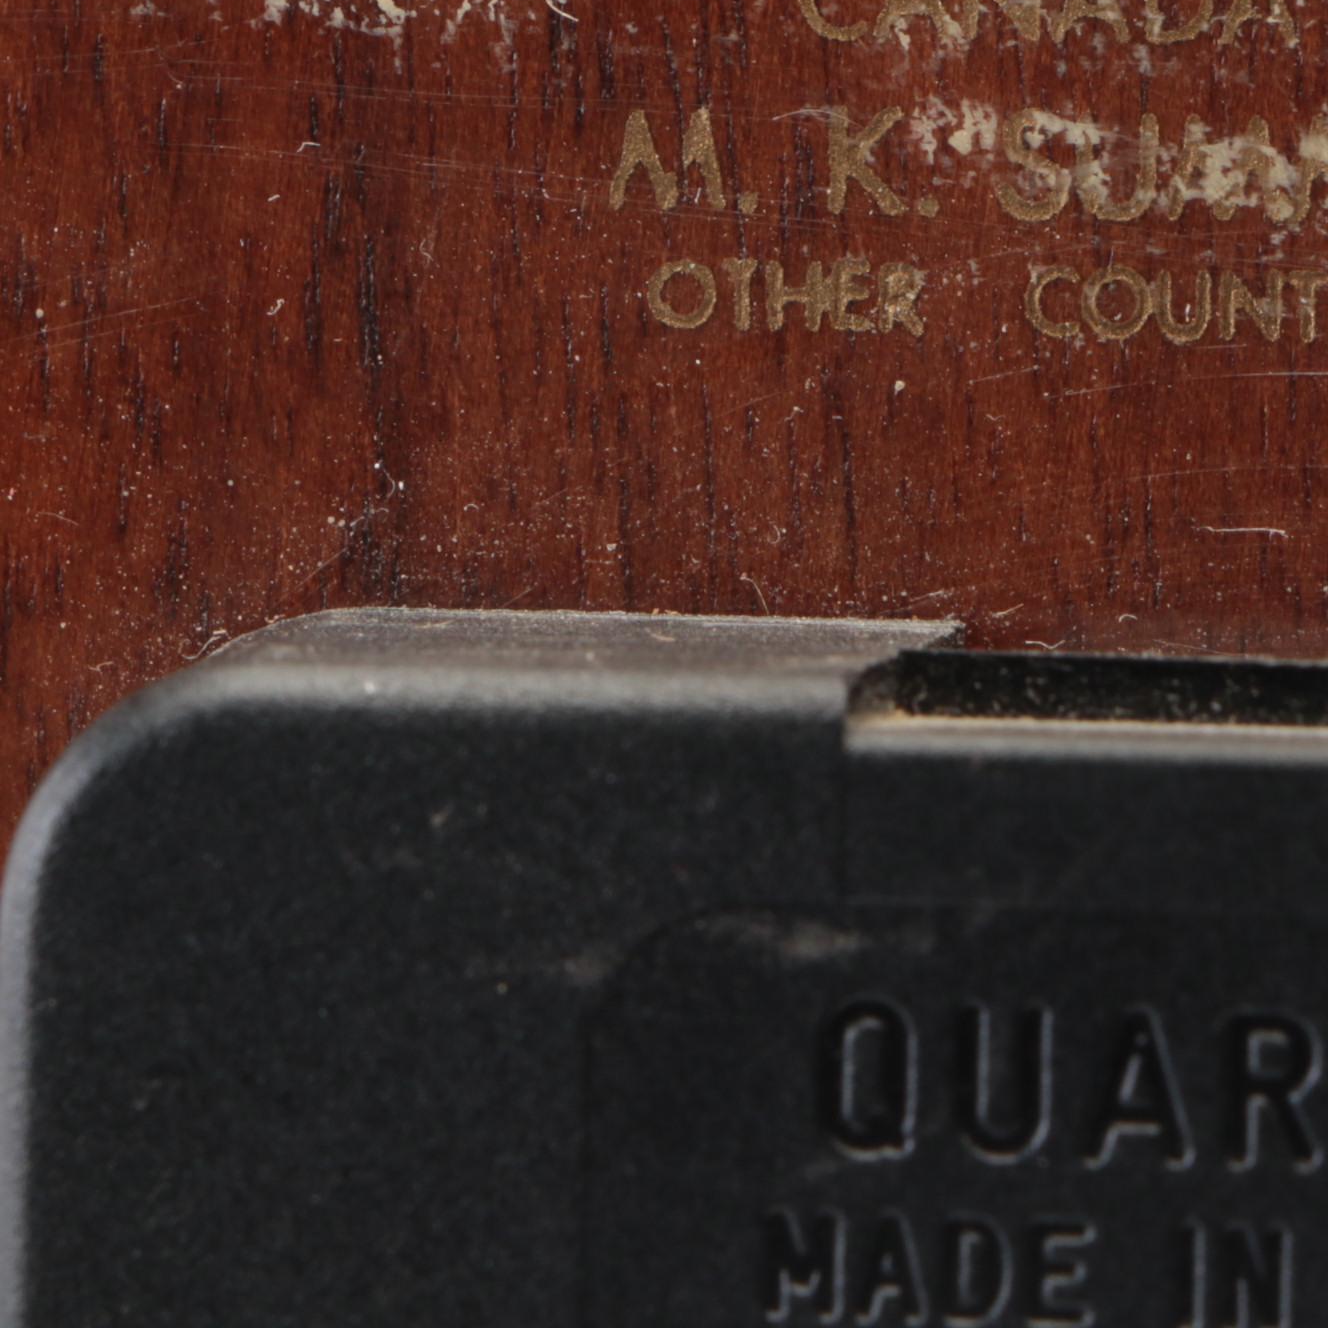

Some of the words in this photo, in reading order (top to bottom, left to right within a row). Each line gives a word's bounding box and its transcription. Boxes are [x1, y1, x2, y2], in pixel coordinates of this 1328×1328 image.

[608, 106, 760, 213] M.
[826, 104, 940, 219] K.
[646, 257, 926, 337] OTHER
[764, 1204, 1098, 1328] MADE
[1178, 1214, 1295, 1328] IN
